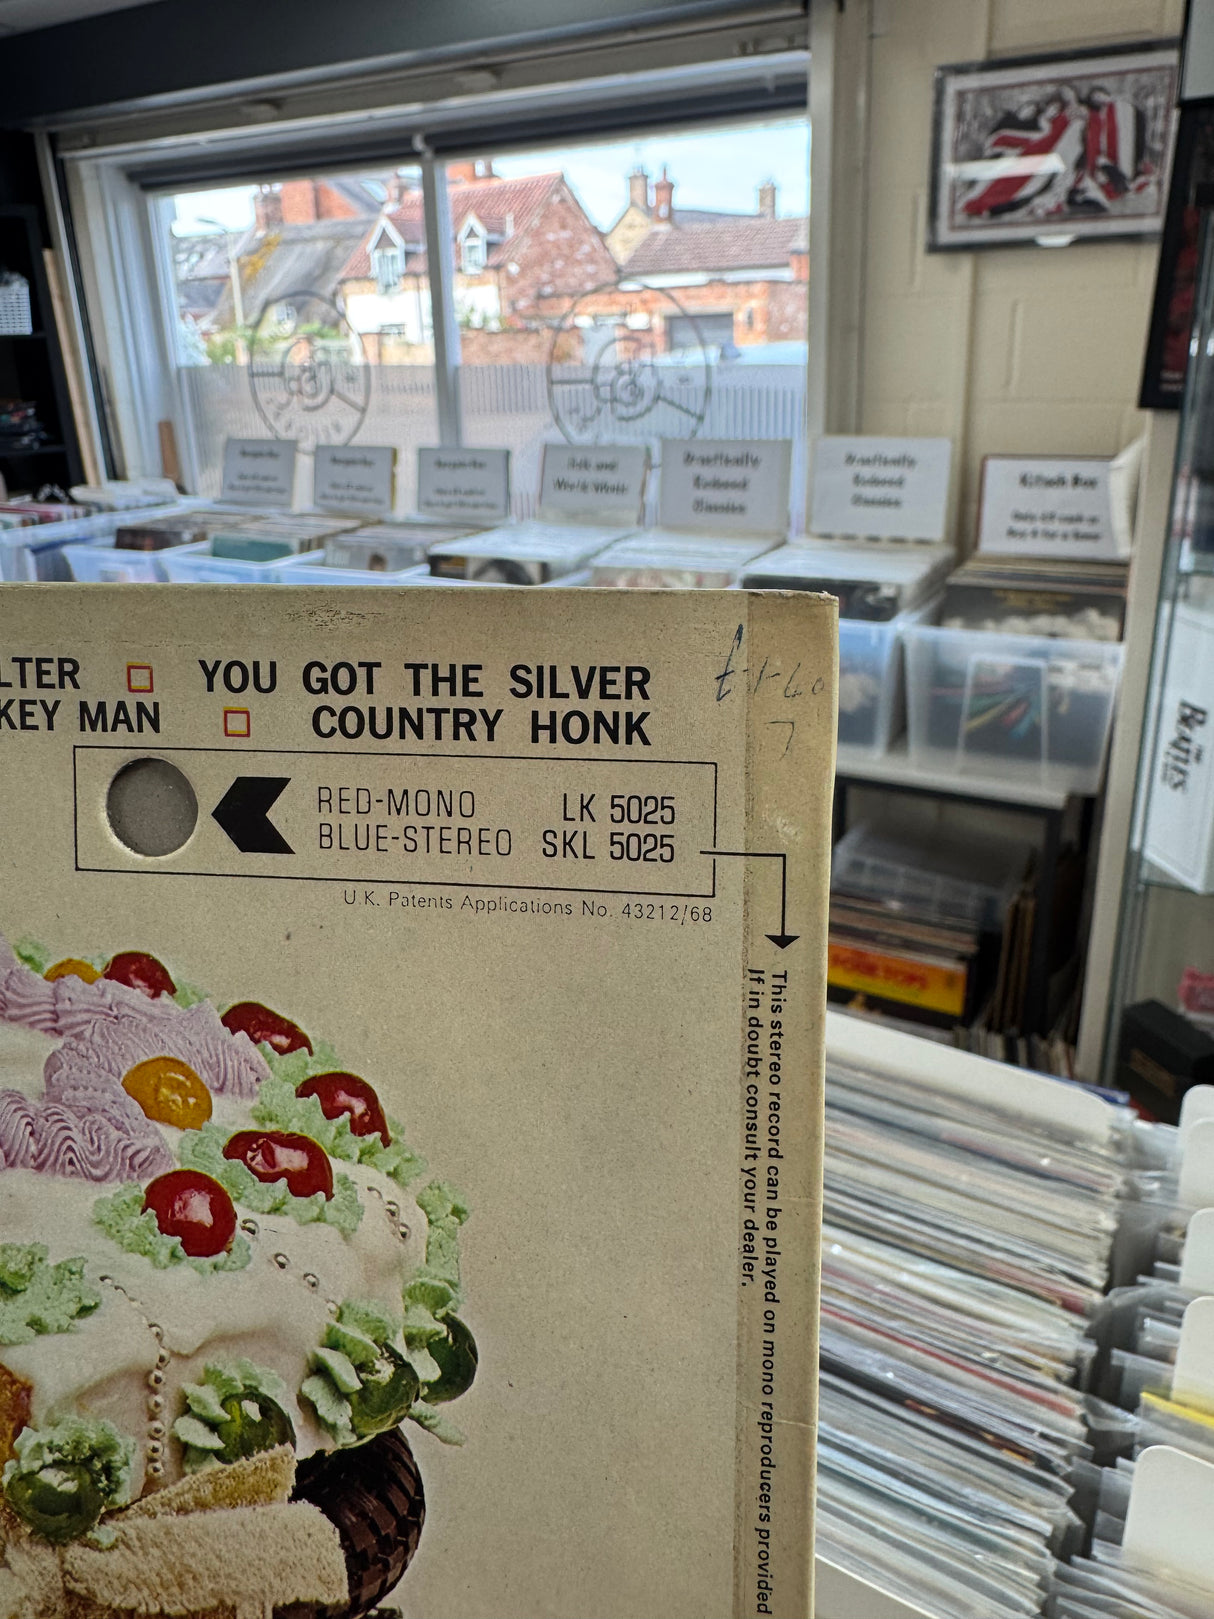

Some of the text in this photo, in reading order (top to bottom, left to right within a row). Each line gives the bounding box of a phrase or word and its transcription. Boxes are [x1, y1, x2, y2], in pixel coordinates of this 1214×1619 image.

[198, 660, 650, 700] YOU GOT THE SILVER
[79, 701, 160, 733] MAN
[312, 705, 651, 746] COUNTRY HONK
[318, 786, 675, 825] RED-MONO LK 5025
[319, 823, 674, 863] BLUE-STEREO SKL 5025
[344, 890, 712, 925] U.K. Patents Applications No. 43212/68
[740, 968, 765, 1286] If in doubt consult your dealer.
[754, 970, 787, 1615] This stereo record can be played on mono reproducers provided
